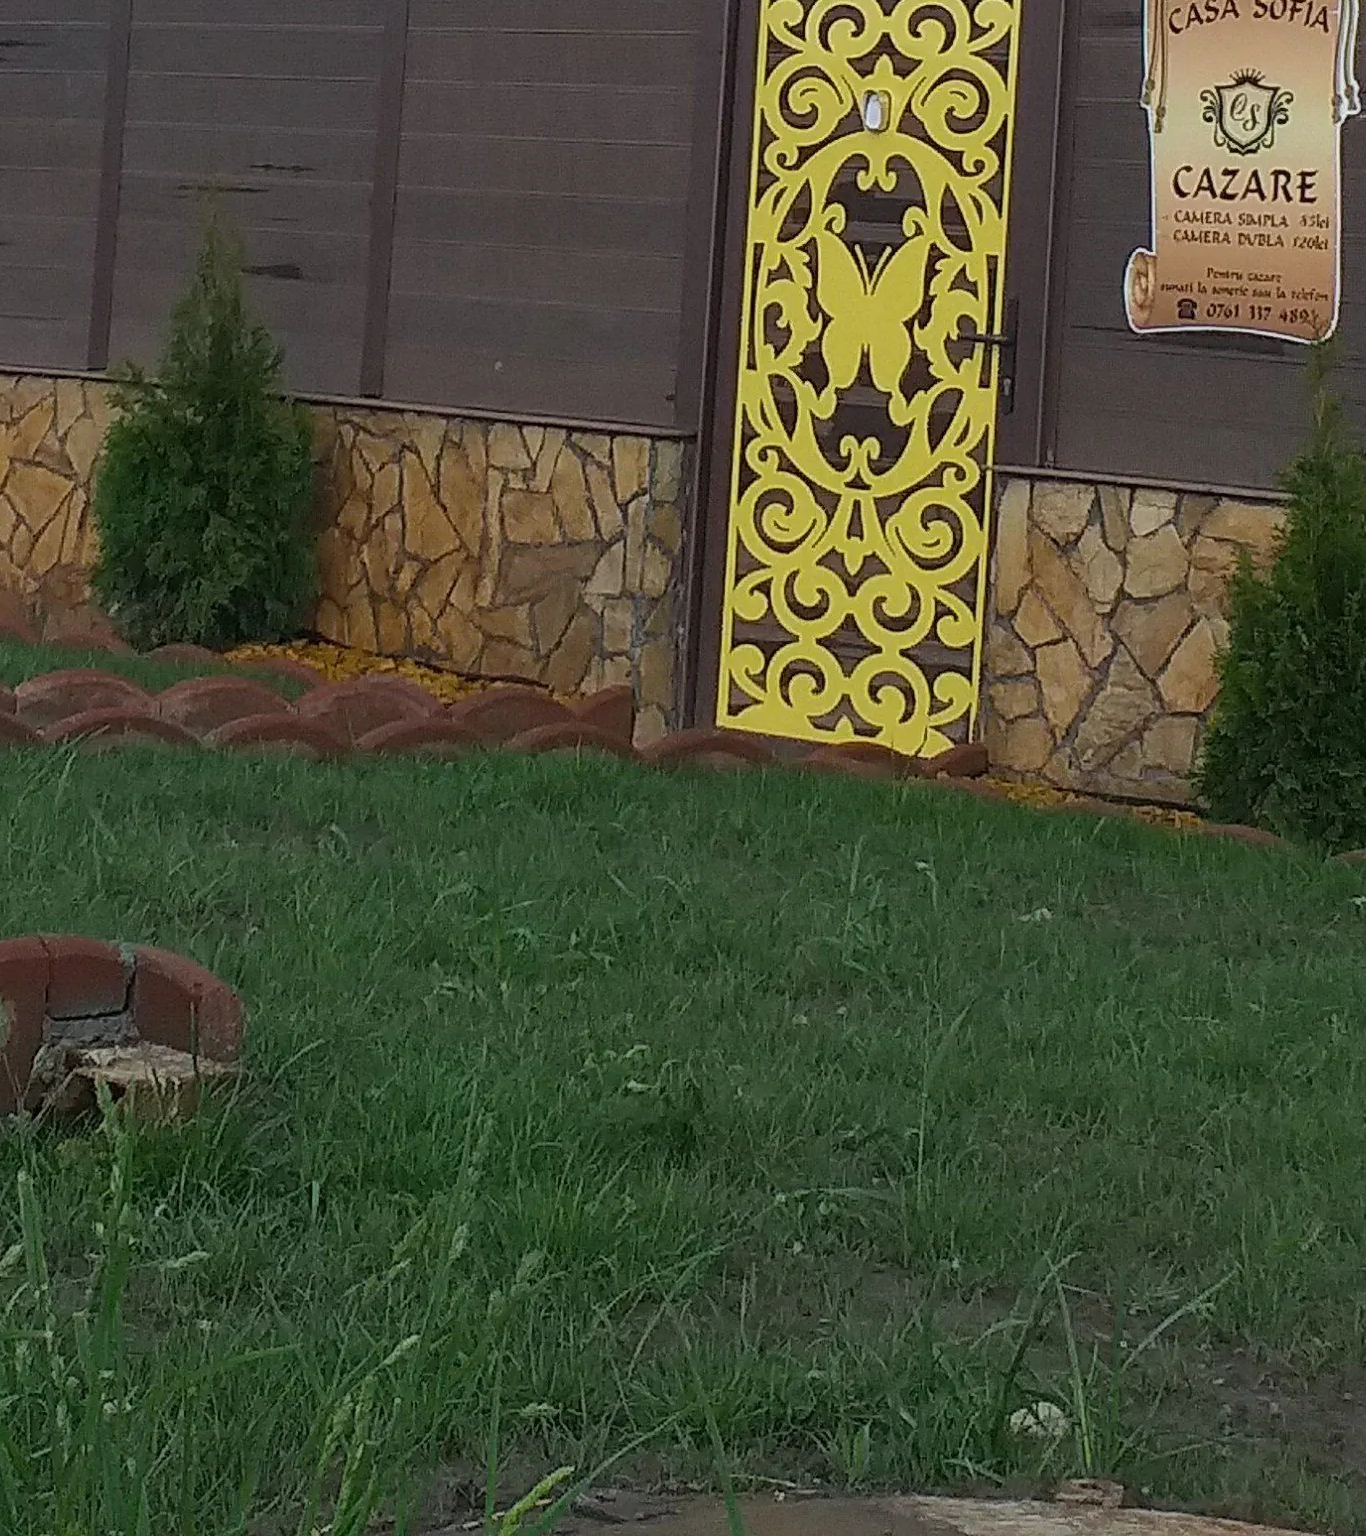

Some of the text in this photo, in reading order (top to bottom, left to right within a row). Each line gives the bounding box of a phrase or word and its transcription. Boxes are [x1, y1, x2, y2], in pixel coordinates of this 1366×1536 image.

[1172, 165, 1319, 204] CAZARE
[1173, 209, 1233, 225] CAMERA
[1237, 212, 1290, 228] SIMPLA
[1172, 228, 1232, 245] CAMERA
[1237, 232, 1285, 248] DUBLA
[1206, 302, 1240, 319] 0761
[1248, 304, 1273, 321] 117
